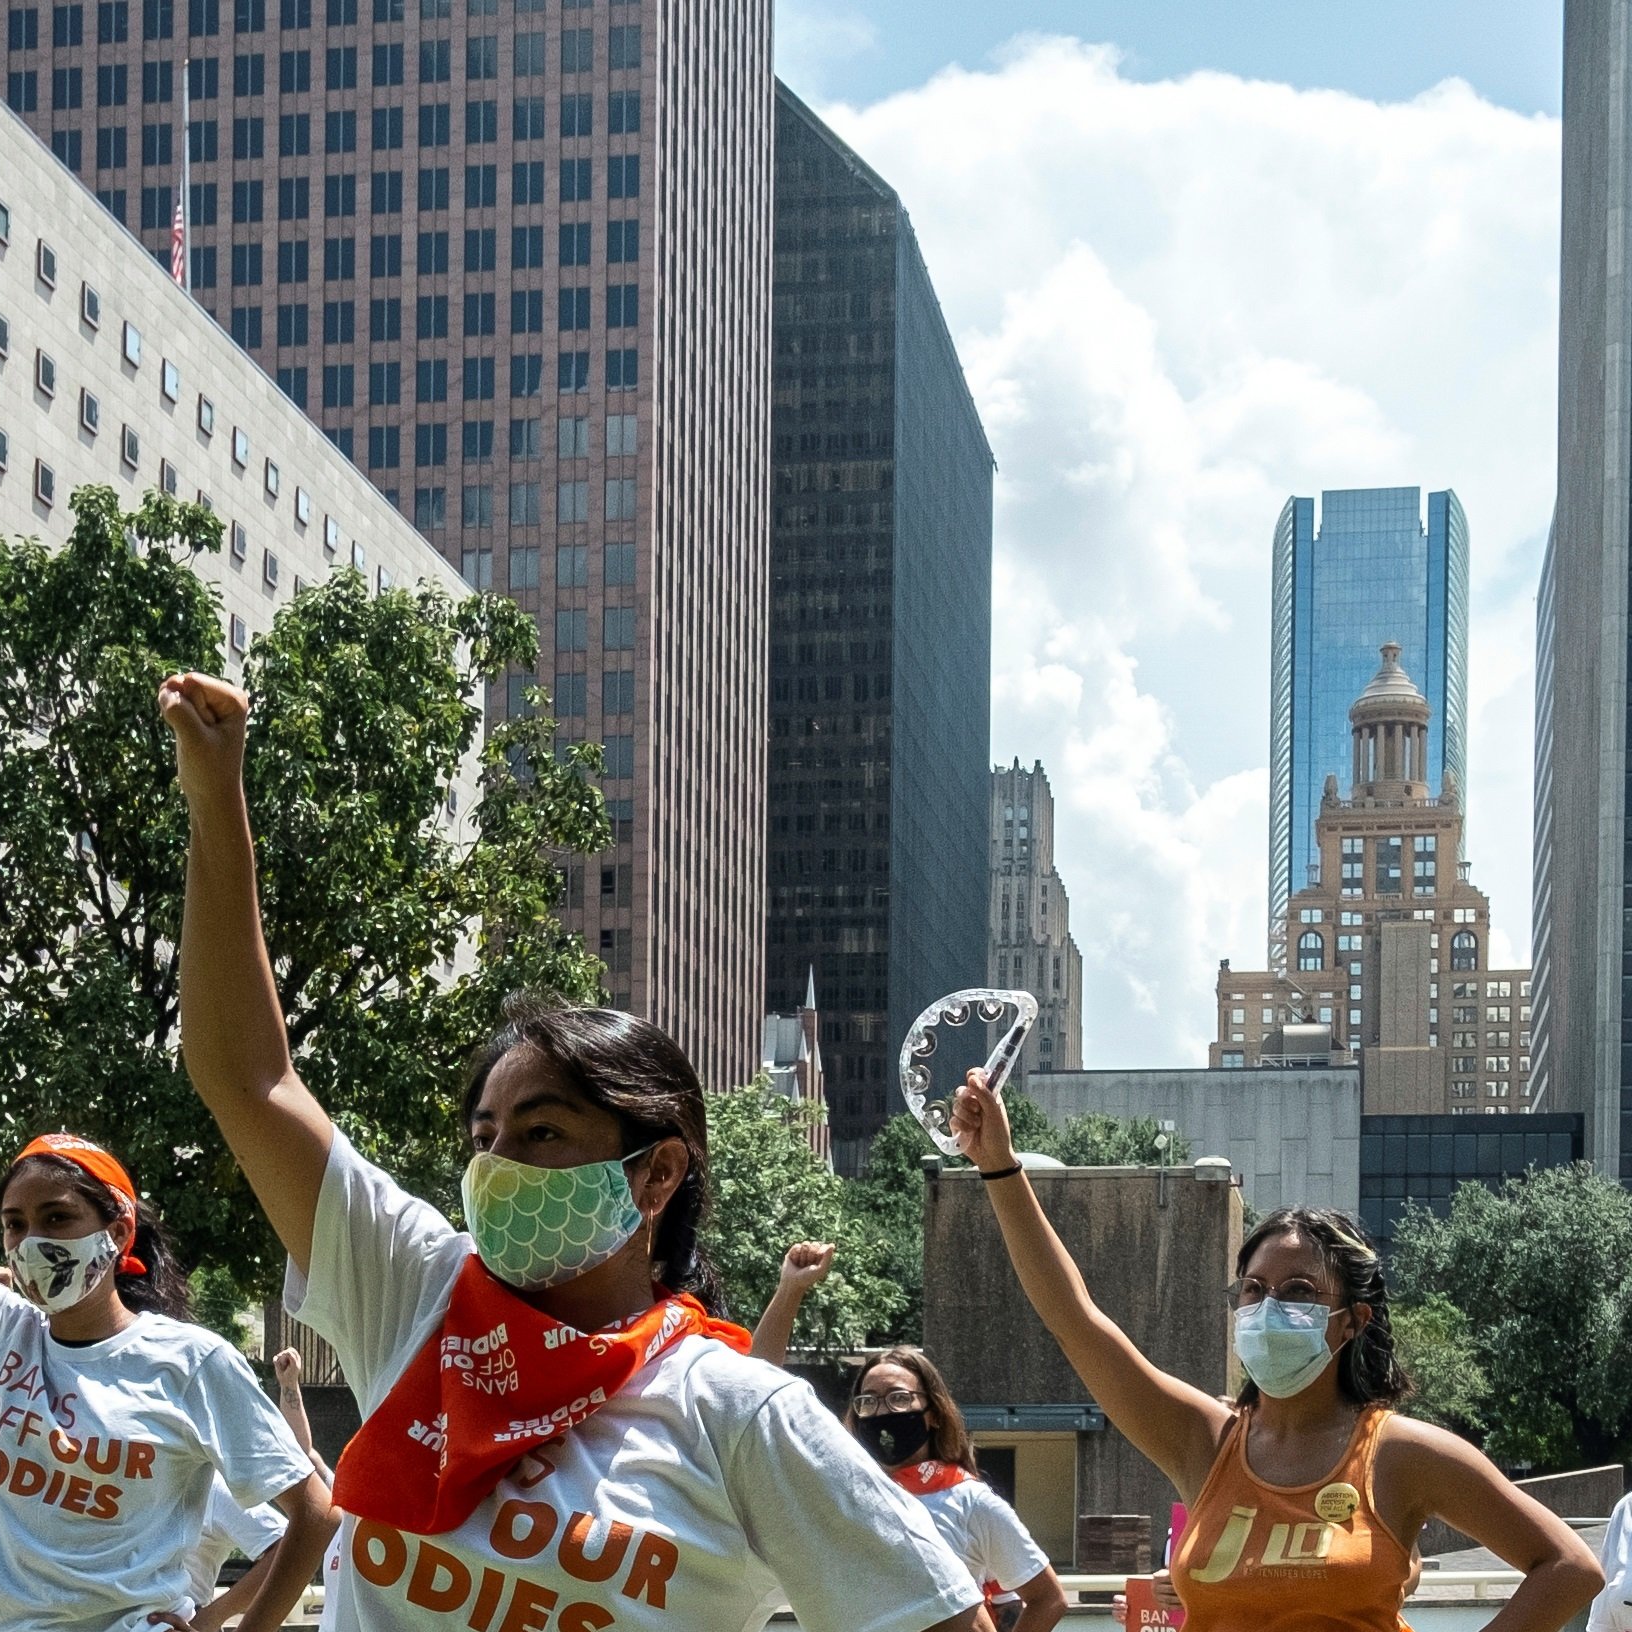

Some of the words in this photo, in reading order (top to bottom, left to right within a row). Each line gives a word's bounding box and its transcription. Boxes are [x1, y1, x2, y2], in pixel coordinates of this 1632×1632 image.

[440, 1353, 474, 1371] OU
[480, 1348, 516, 1377] OFF
[462, 1370, 519, 1397] BANS
[508, 1386, 607, 1432] BODIES
[493, 1423, 556, 1443] OUR
[48, 1428, 156, 1480] OUR
[489, 1498, 680, 1610] OUR
[1140, 1609, 1170, 1625] BAN
